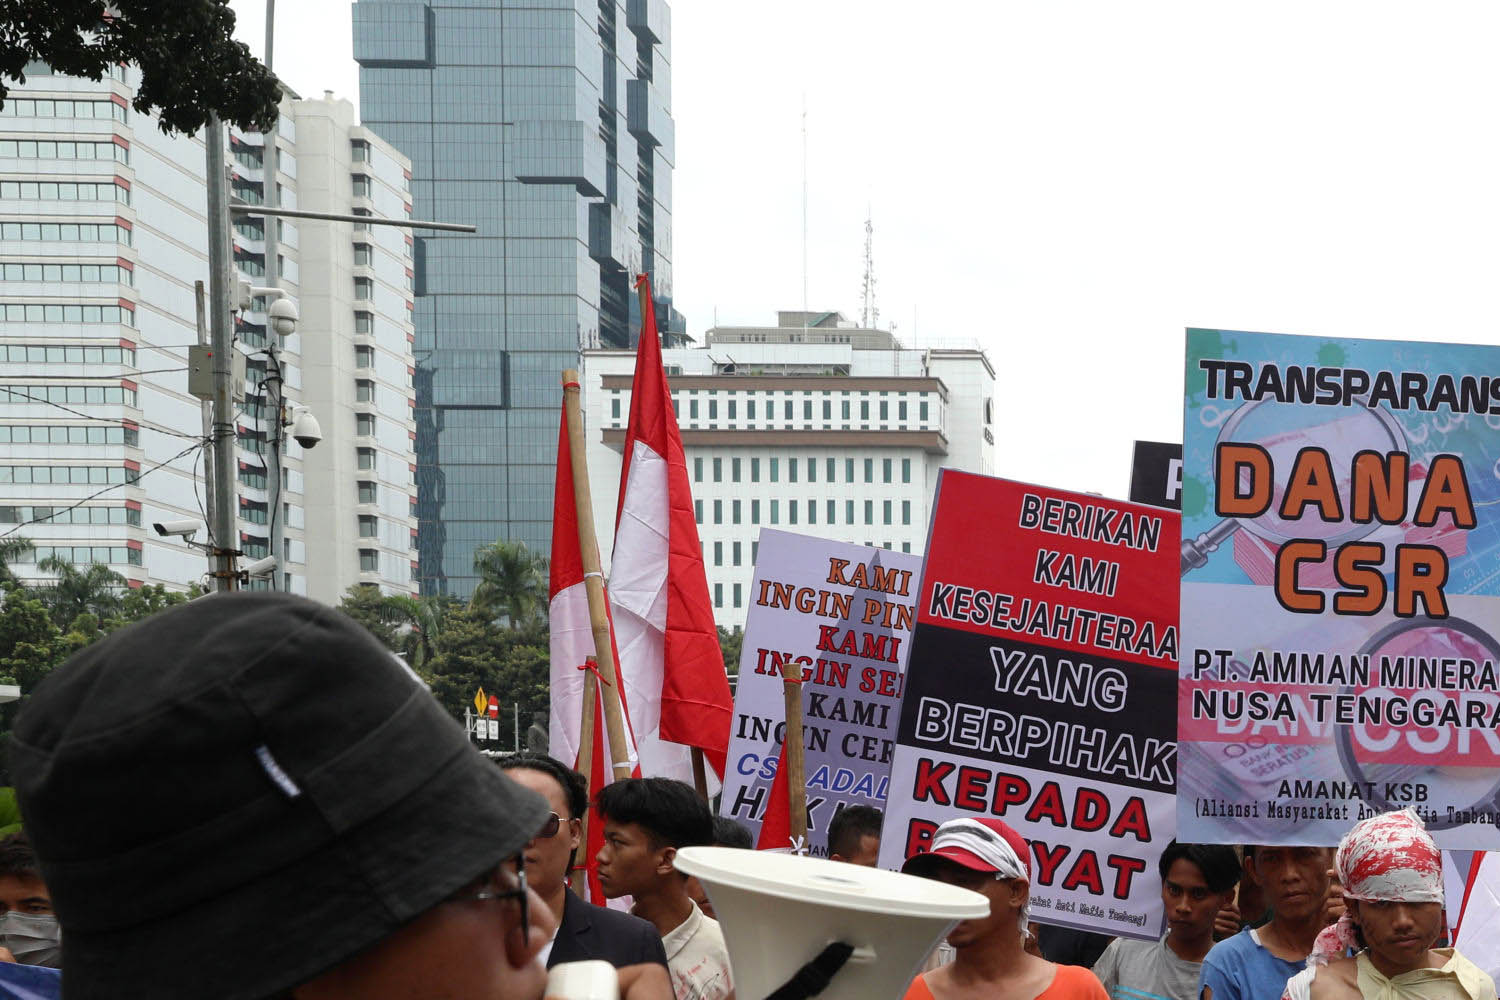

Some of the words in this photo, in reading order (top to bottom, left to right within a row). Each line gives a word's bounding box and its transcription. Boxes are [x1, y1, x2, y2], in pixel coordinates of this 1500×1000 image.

[1215, 442, 1478, 530] DANA
[1018, 493, 1162, 552] BERIKAN
[826, 557, 912, 597] KAMI
[1033, 549, 1120, 598] KAMI
[1274, 538, 1451, 620] CSR
[757, 579, 854, 621] INGIN
[816, 624, 902, 663] KAMI
[989, 646, 1128, 711] YANG
[1193, 649, 1239, 682] PT.
[1249, 651, 1371, 688] AMMAN
[807, 692, 891, 730] KAMI
[1192, 689, 1297, 722] NUSA
[914, 697, 1177, 785] BERPIHAK
[912, 758, 1152, 843] KEPADA
[1195, 800, 1258, 819] (Aliansi
[1267, 802, 1348, 822] Masyarakat
[1277, 779, 1377, 801] AMANAT
[1385, 783, 1429, 802] KSB
